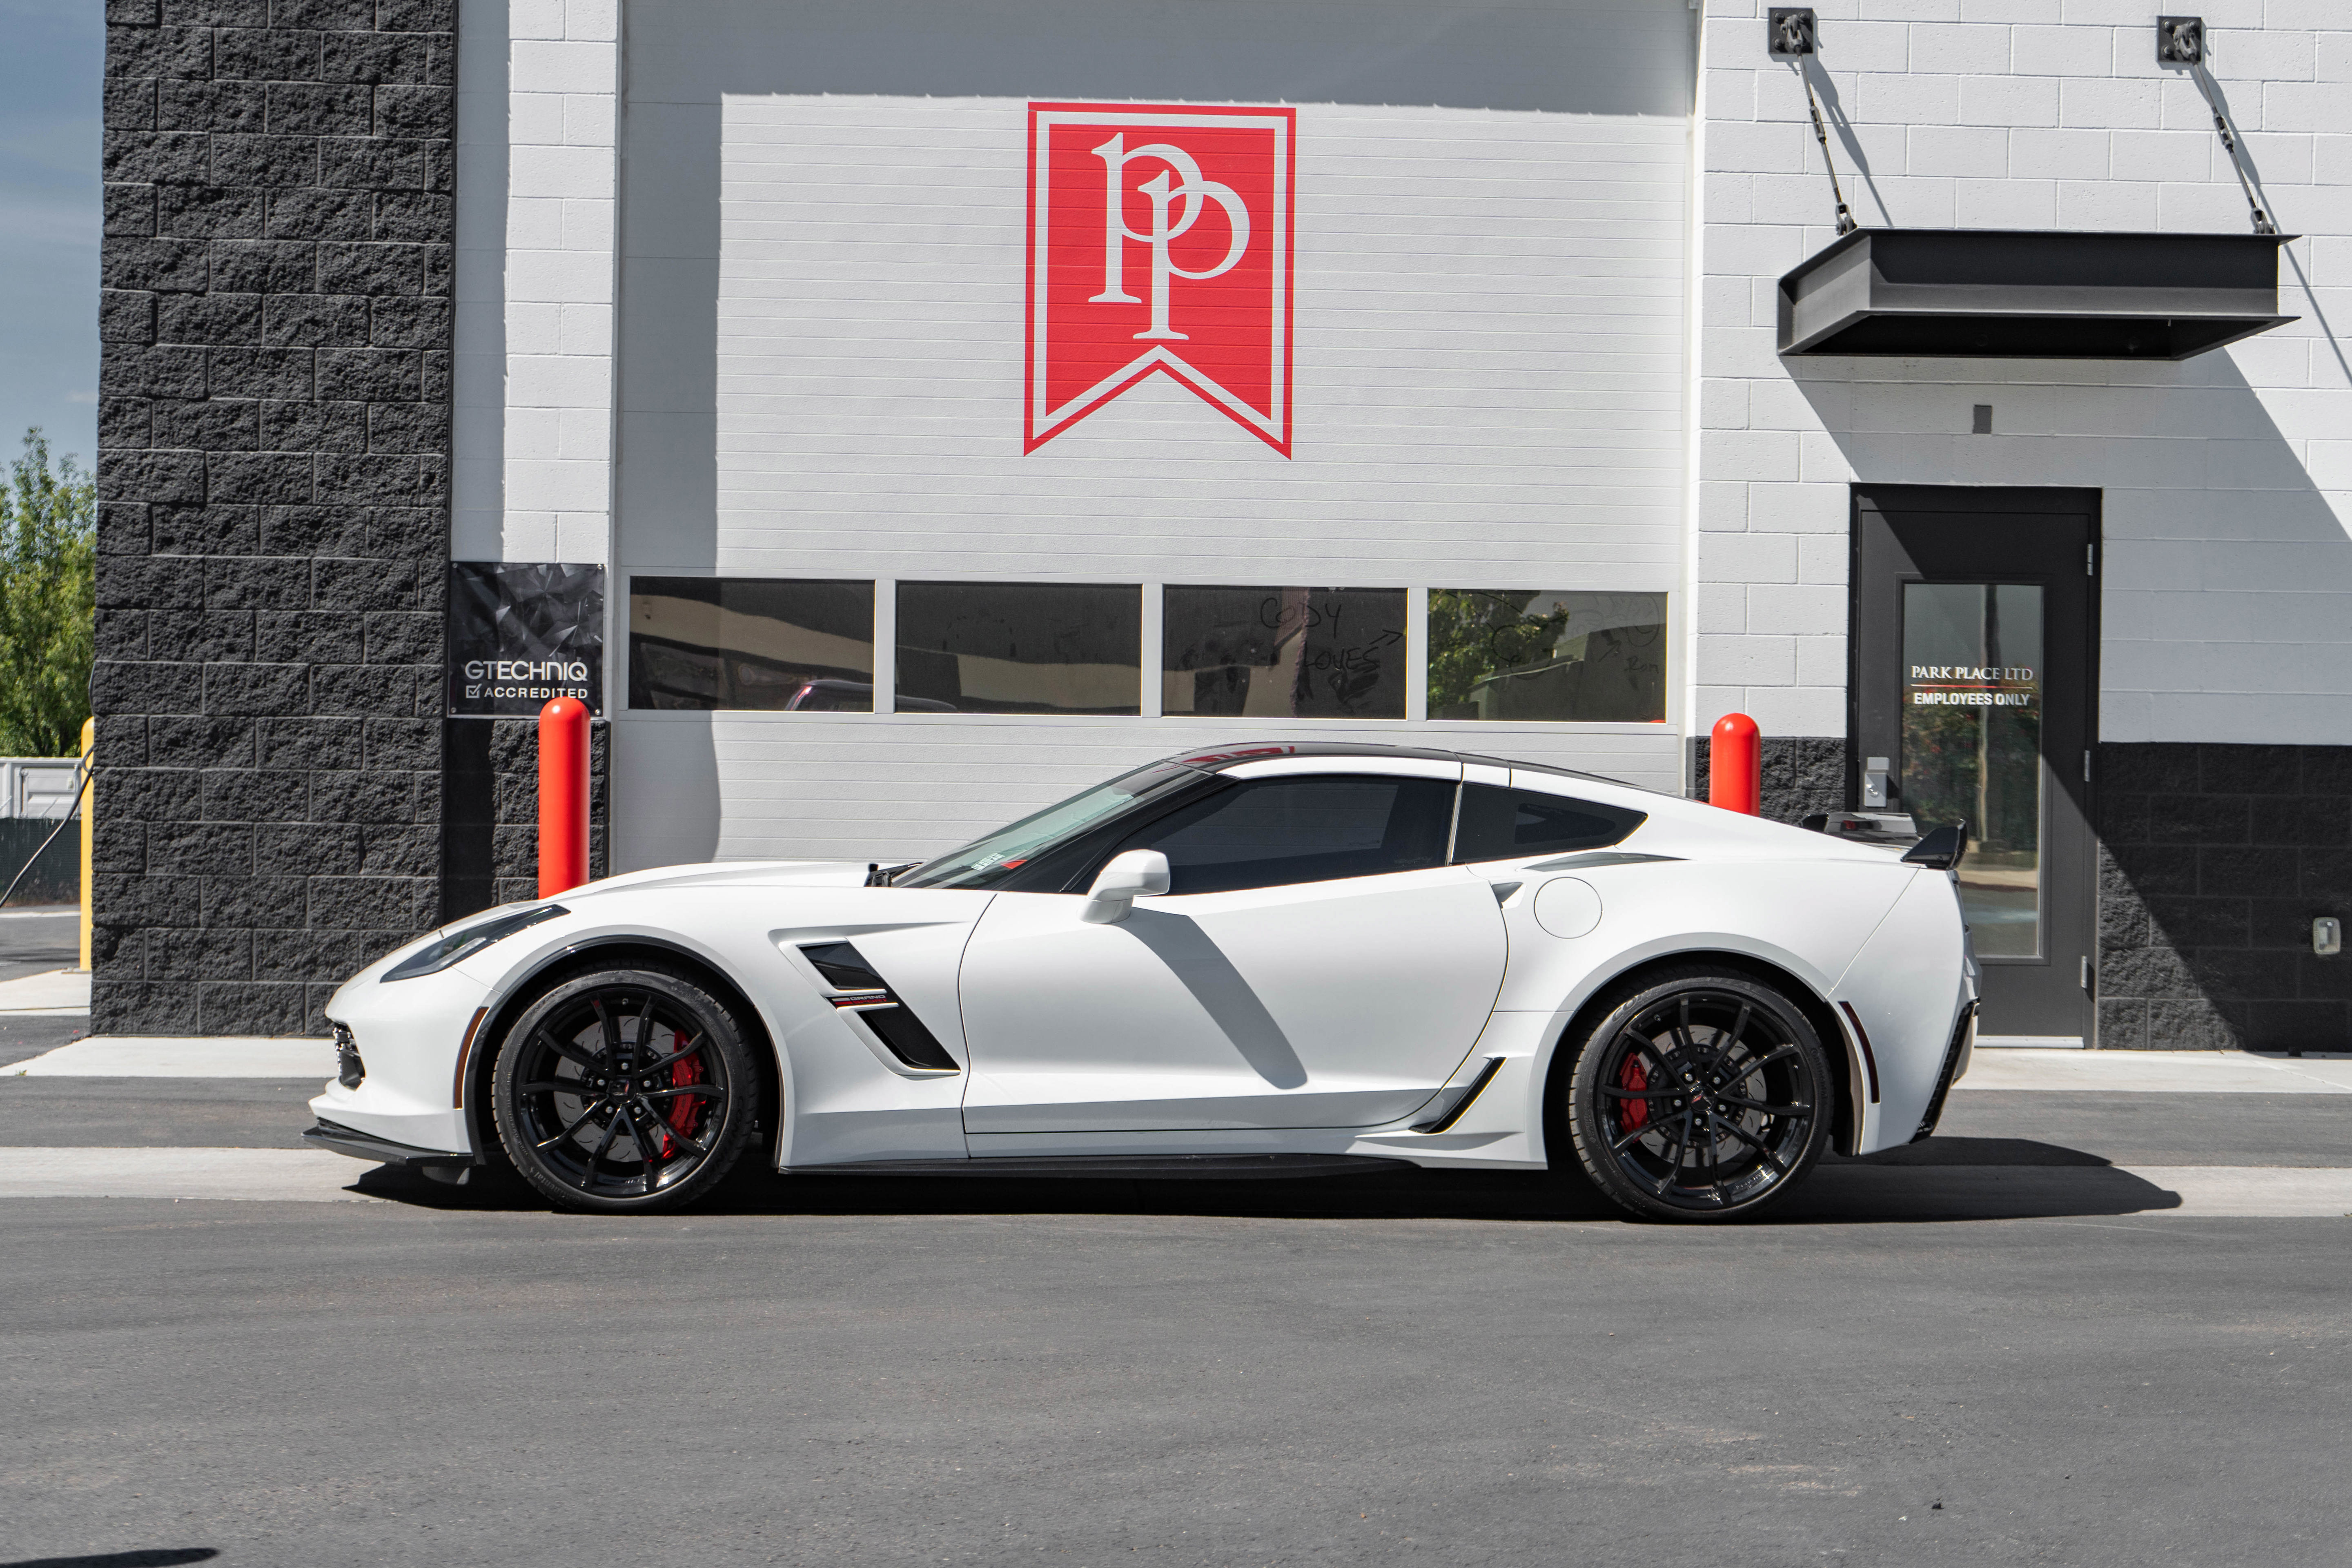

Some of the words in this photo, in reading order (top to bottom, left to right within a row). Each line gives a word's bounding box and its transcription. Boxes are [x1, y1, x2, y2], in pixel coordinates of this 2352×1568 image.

[465, 660, 588, 682] GTECHNIQ
[1911, 666, 1953, 679] PARK
[1955, 667, 2000, 680] PLACE
[2004, 668, 2034, 681] LTD
[484, 687, 588, 699] ACCREDITED
[1914, 693, 1993, 705] EMPLOYEES
[1995, 693, 2031, 706] ONLY
